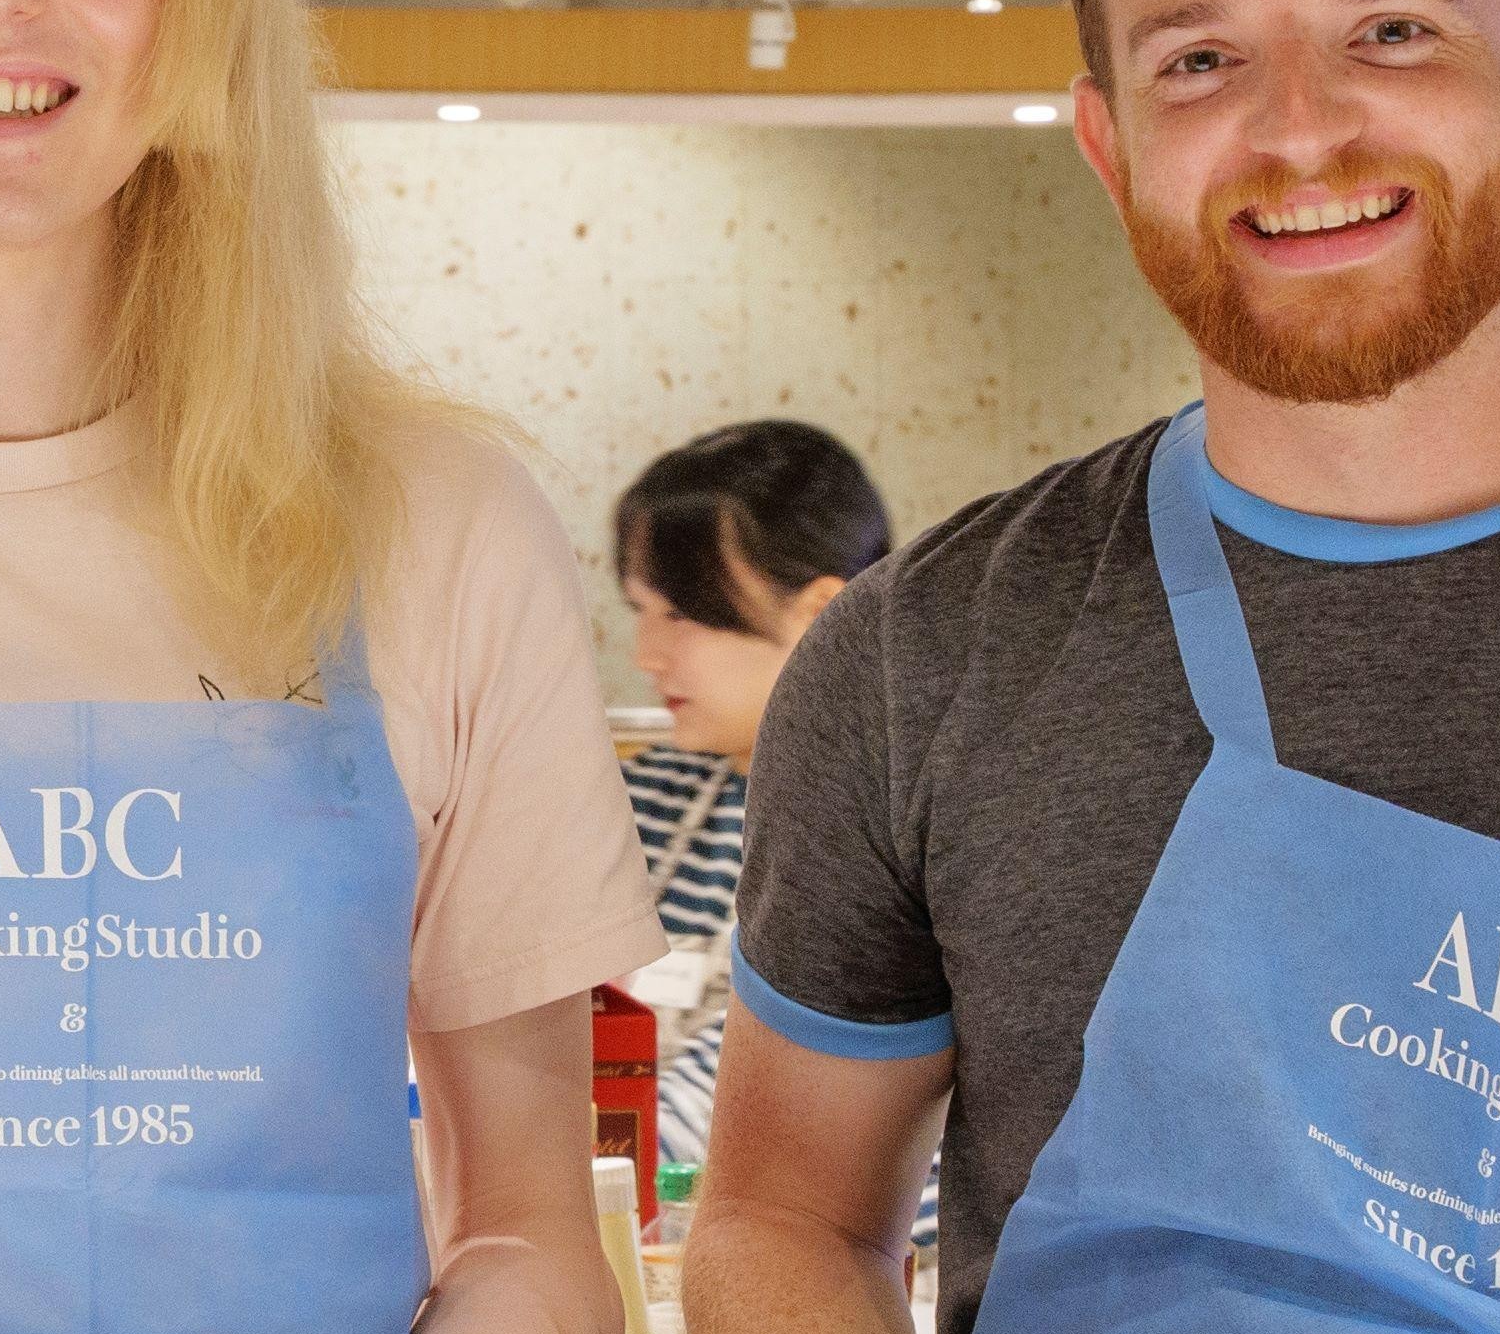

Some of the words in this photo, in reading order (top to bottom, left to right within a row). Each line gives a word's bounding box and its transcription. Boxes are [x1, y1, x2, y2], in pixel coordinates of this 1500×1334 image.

[95, 912, 262, 961] Studio
[59, 1003, 86, 1033] &
[9, 1066, 63, 1085] dining
[65, 1065, 106, 1082] tables
[109, 1065, 128, 1082] all
[130, 1065, 188, 1083] around
[190, 1065, 214, 1082] the
[216, 1067, 264, 1083] world.
[89, 1104, 194, 1147] 1985
[1307, 1124, 1365, 1171] Bringing
[1363, 1164, 1408, 1193] smiles
[1410, 1182, 1428, 1199] to
[1428, 1188, 1475, 1220] dining
[1477, 1147, 1497, 1179] &
[1363, 1198, 1476, 1285] Since
